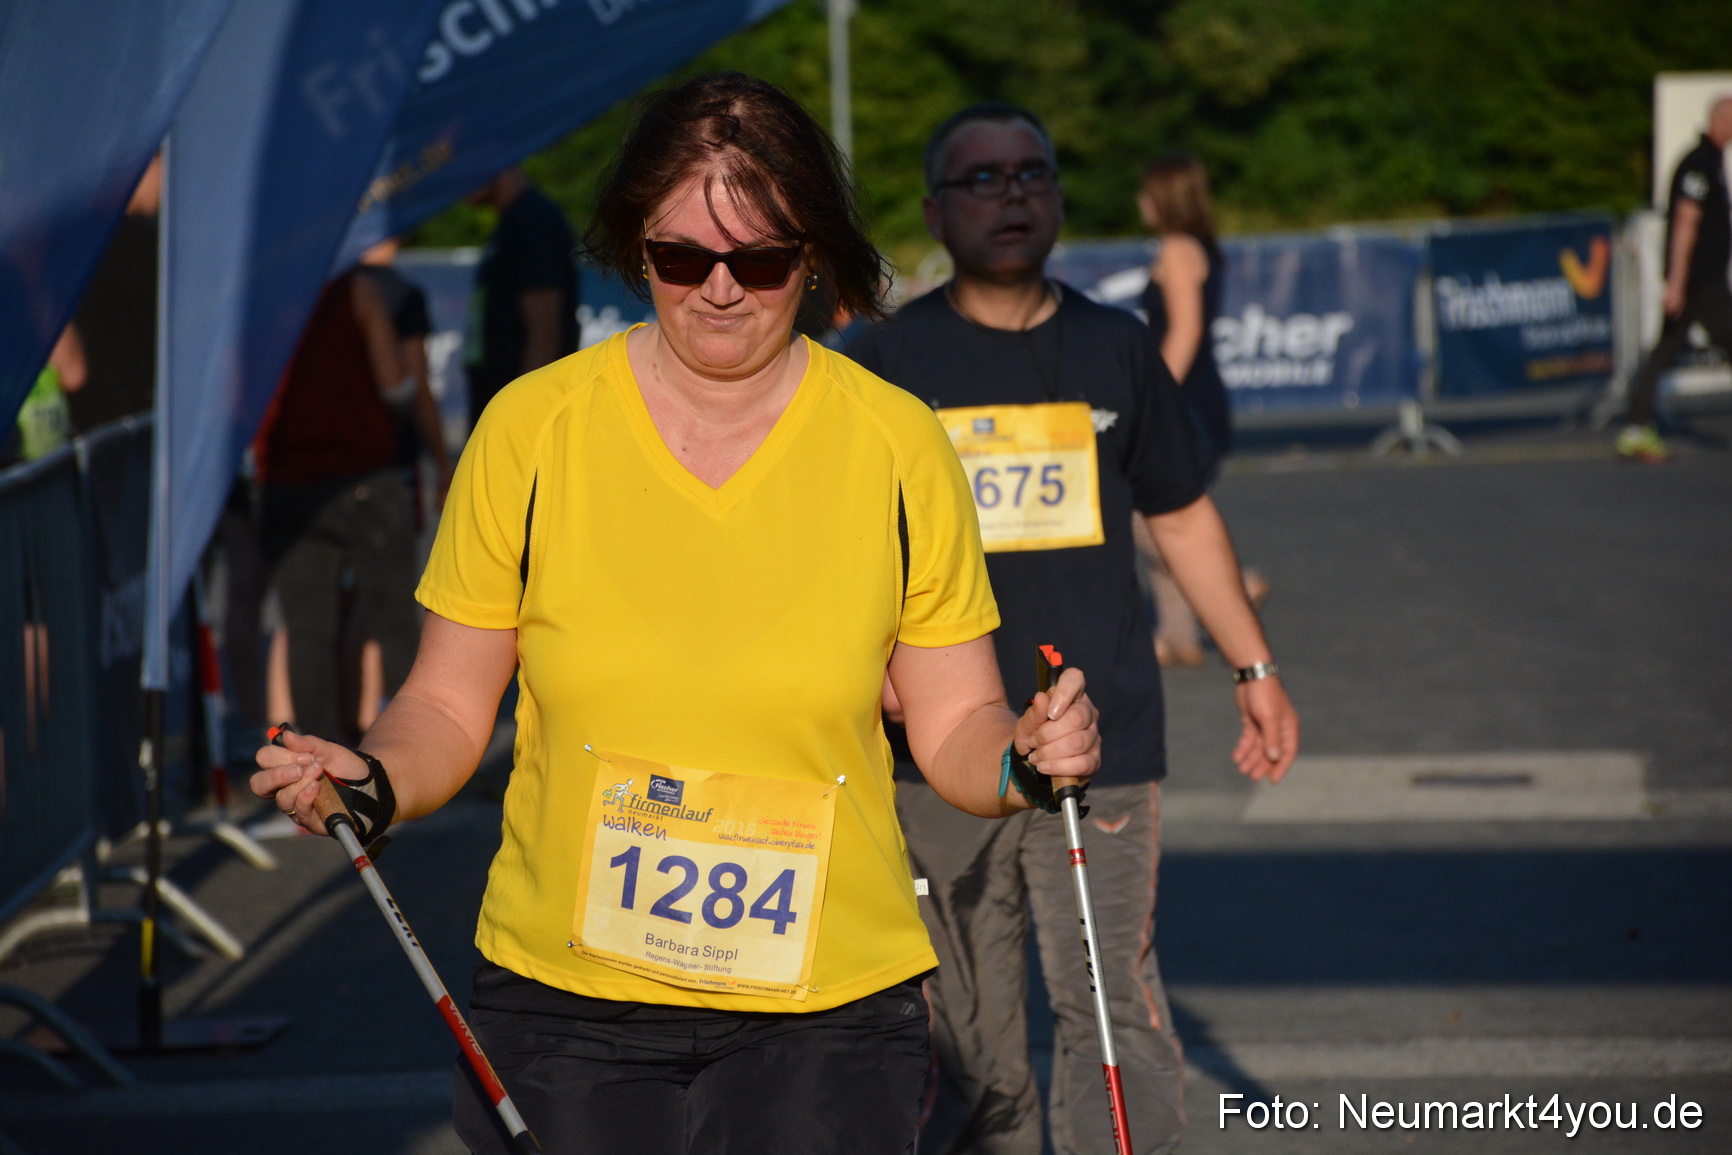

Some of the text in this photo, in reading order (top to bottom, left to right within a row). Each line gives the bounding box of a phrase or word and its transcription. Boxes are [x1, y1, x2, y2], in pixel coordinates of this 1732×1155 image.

[973, 454, 1066, 509] 675
[627, 809, 664, 821] neumarkt
[629, 794, 714, 823] firmenlauf
[603, 814, 667, 841] walken
[712, 819, 757, 836] 2016
[609, 845, 797, 935] 1284
[645, 932, 738, 962] Barbara Sippl
[703, 963, 732, 974] Stiftung
